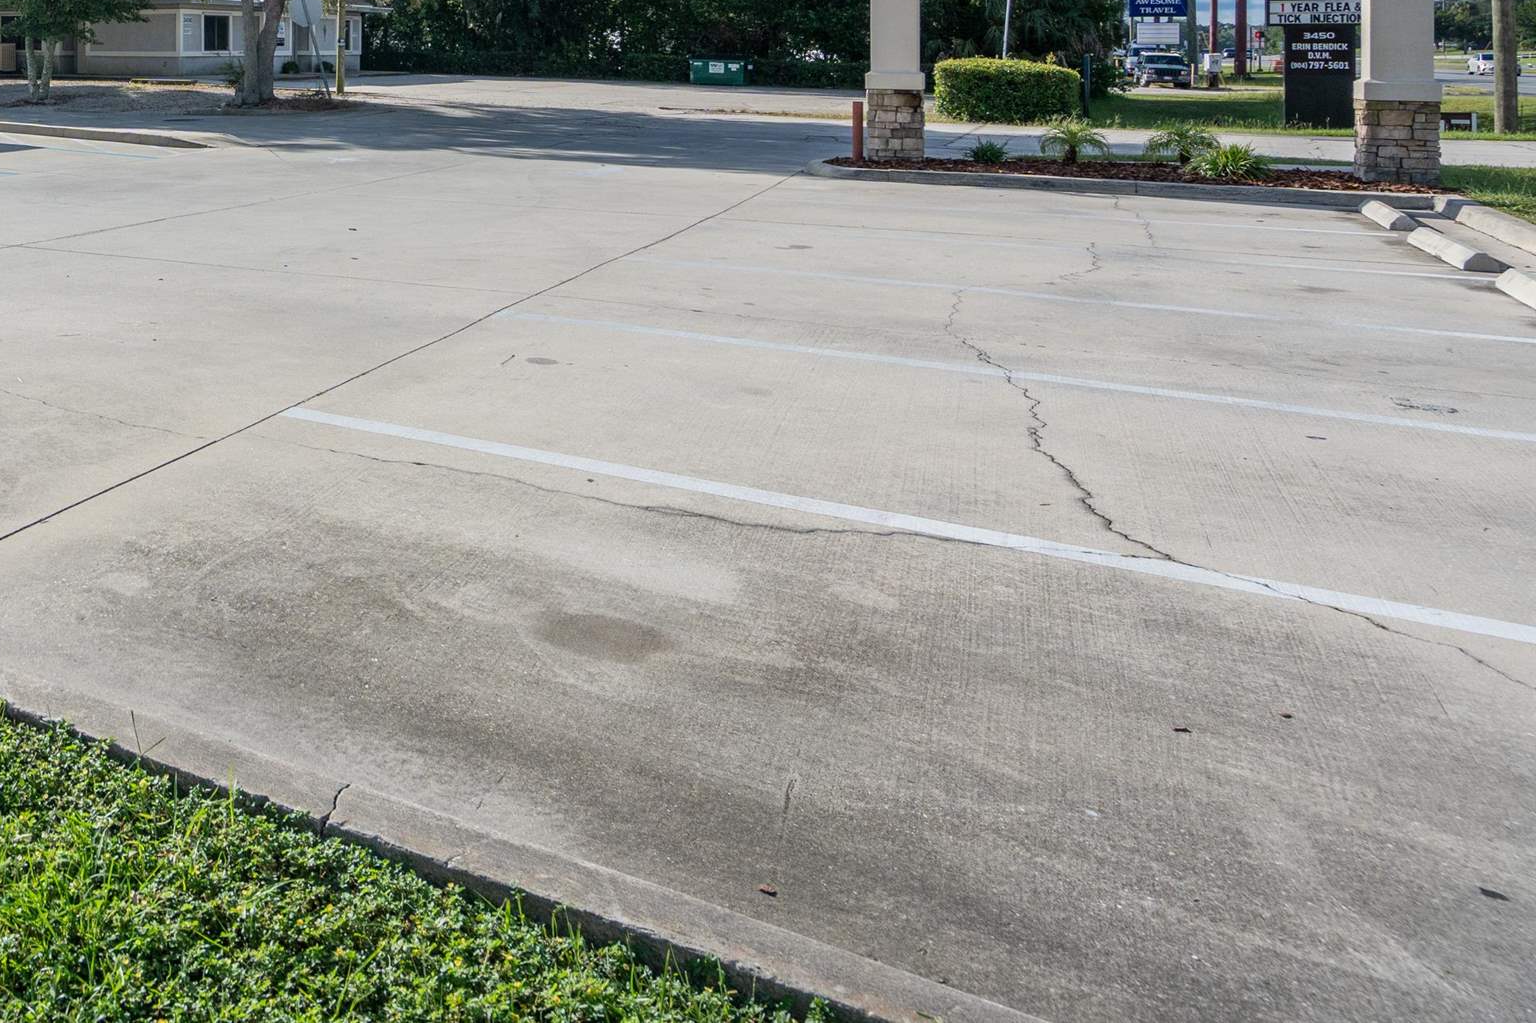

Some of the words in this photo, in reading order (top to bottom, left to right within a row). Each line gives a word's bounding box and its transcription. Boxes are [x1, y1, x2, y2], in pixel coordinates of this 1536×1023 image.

[1290, 2, 1319, 13] YEAR
[1324, 2, 1351, 12] FLEA
[1277, 14, 1301, 24] TICK
[1303, 32, 1336, 40] 3450
[1291, 43, 1311, 51] ERIN
[1312, 43, 1349, 51] BENDICK
